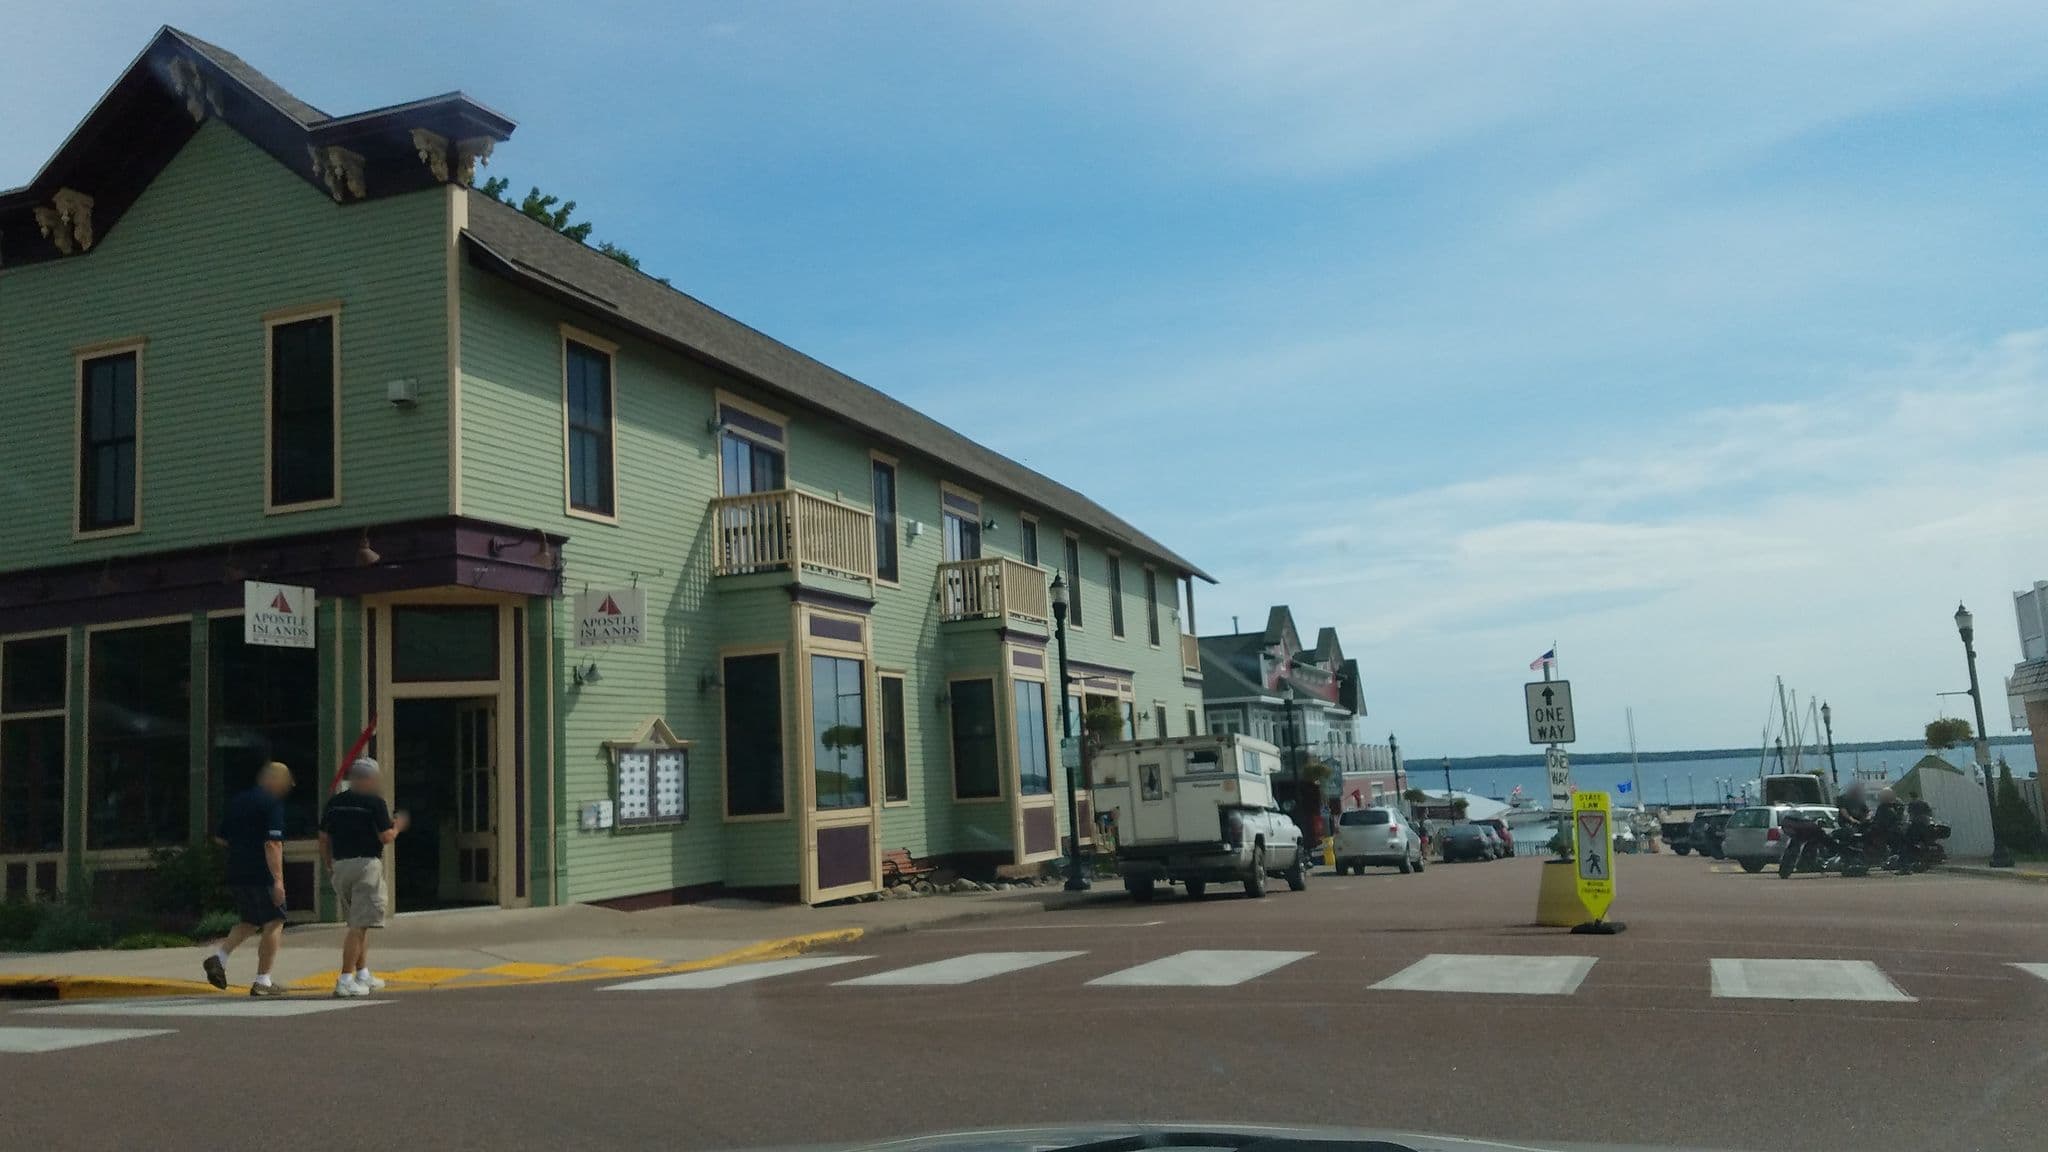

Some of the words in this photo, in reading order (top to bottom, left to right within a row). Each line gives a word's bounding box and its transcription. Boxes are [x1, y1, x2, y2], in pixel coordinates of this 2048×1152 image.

[255, 613, 306, 626] APOSTLE
[582, 616, 638, 627] APOSTLE
[252, 624, 309, 636] ISLANDS
[580, 627, 640, 638] ISLANDS
[1535, 707, 1565, 723] ONE
[1537, 725, 1565, 740] WAY
[1549, 753, 1568, 769] ONE
[1551, 772, 1569, 786] WAY
